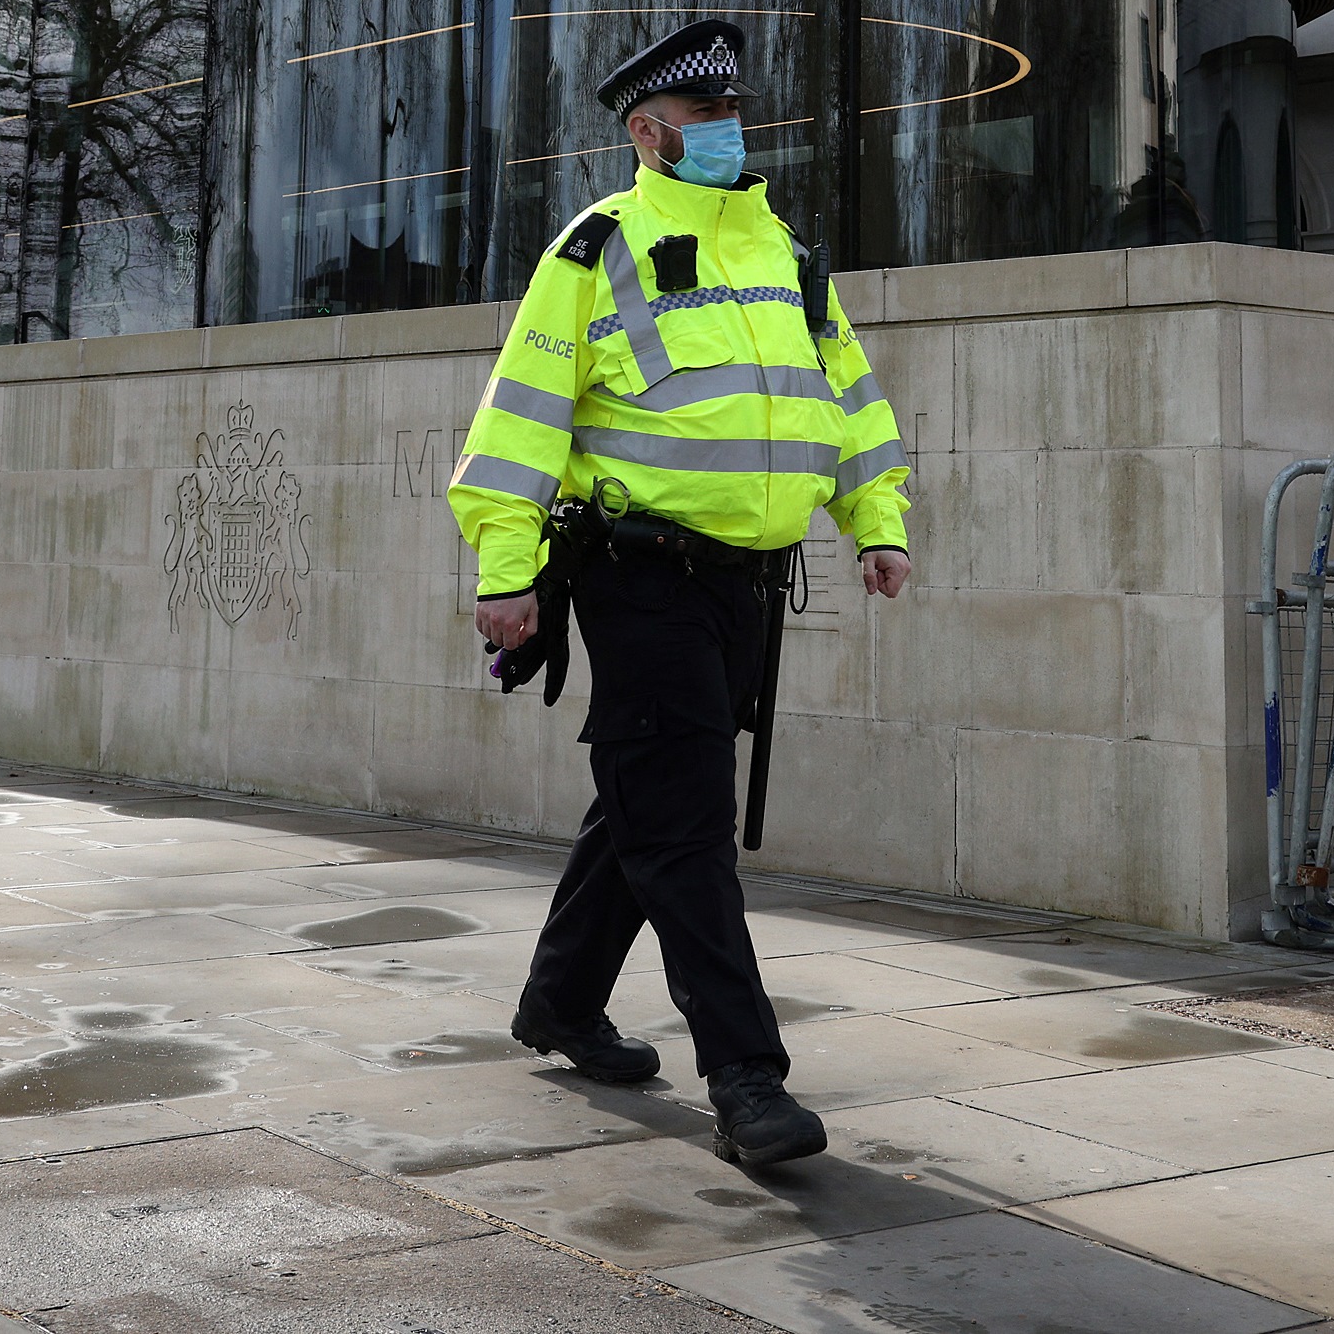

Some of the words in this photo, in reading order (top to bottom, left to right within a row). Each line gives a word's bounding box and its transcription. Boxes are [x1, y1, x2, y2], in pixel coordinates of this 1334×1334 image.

[575, 239, 589, 250] SE
[567, 245, 587, 259] 1336
[524, 328, 576, 360] POLICE
